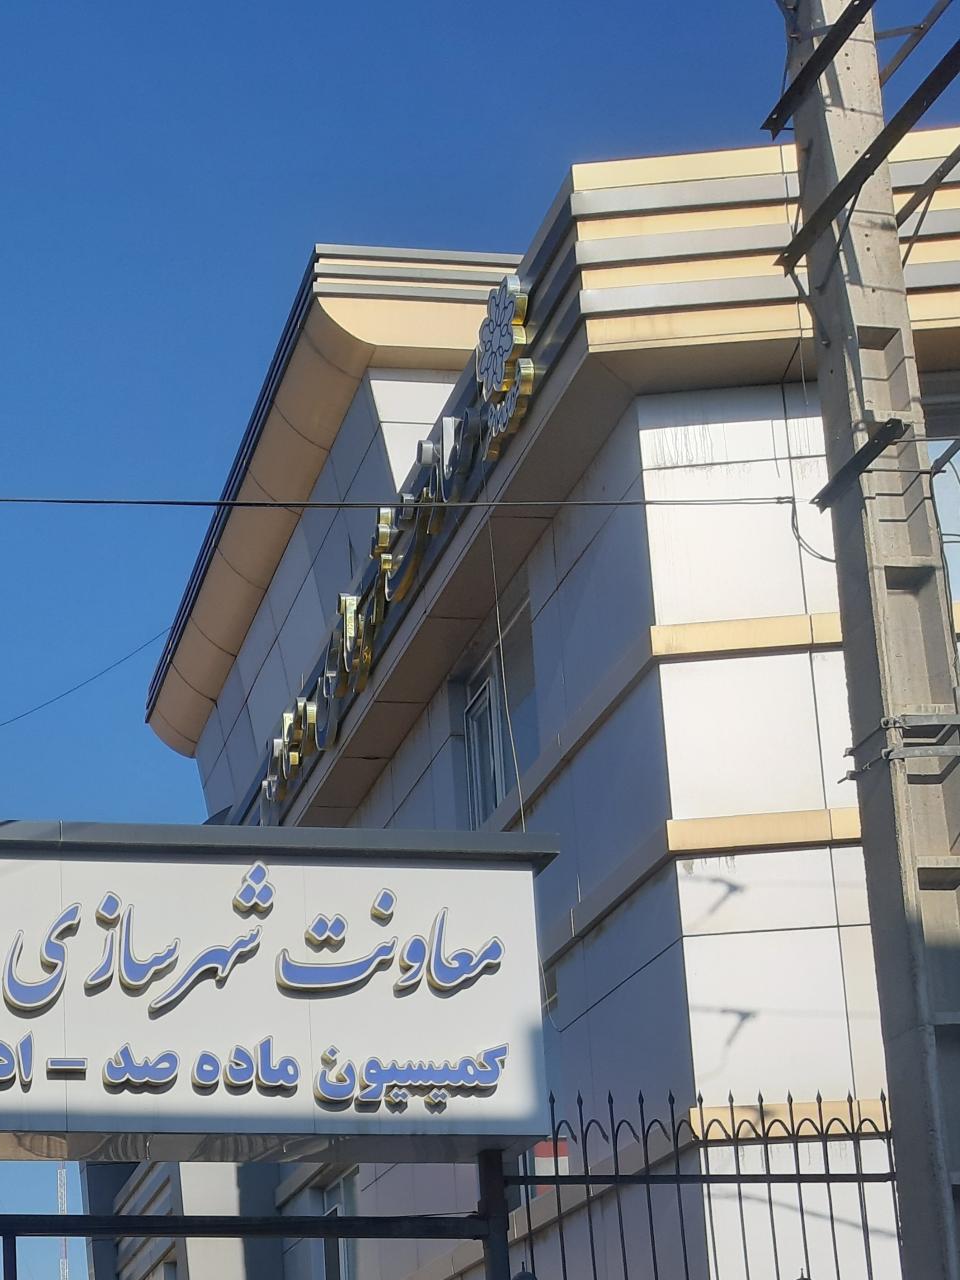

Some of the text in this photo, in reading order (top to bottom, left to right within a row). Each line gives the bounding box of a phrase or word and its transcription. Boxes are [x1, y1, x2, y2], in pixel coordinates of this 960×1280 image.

[4, 860, 276, 1018] شهرسازی
[275, 886, 505, 999] معاونت
[102, 1041, 181, 1096] صد
[191, 1034, 300, 1097] ماده
[313, 1042, 510, 1113] کمیسیون
